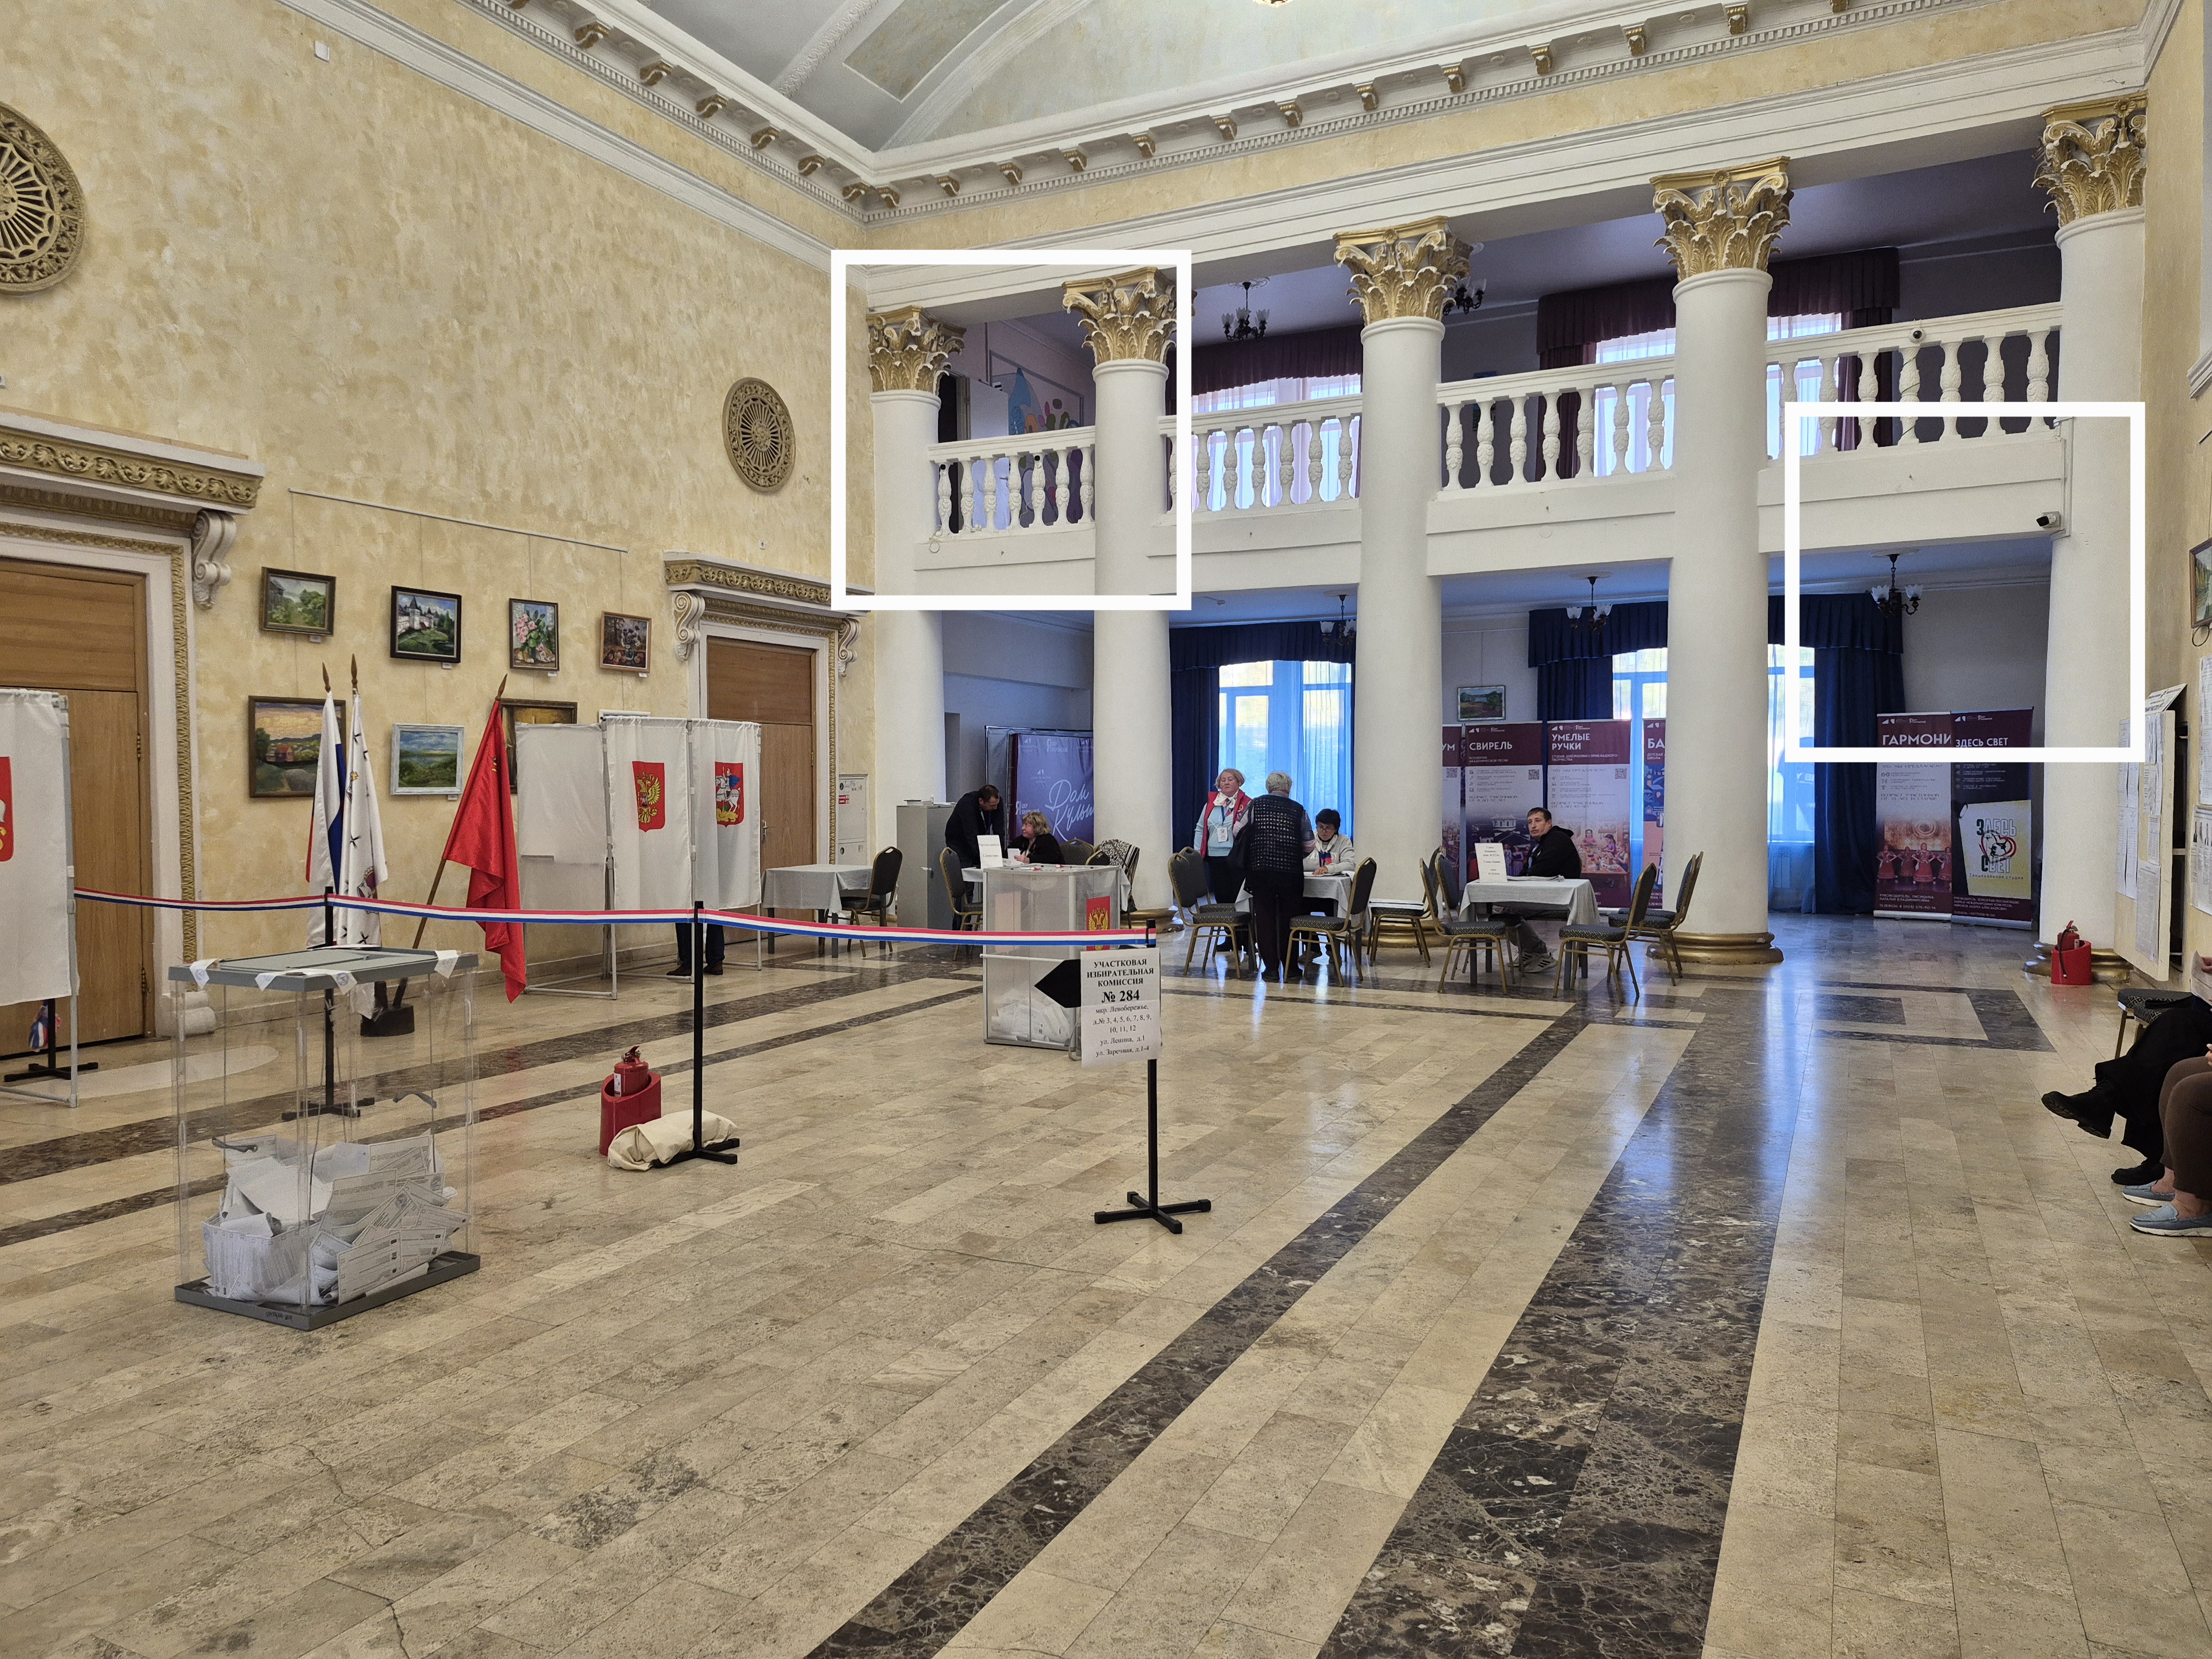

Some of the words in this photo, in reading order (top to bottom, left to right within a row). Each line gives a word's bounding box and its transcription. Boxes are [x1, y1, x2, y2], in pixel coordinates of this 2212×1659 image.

[1551, 733, 1590, 742] УМЕЛЫЕ
[1882, 733, 1951, 745] ГАРМОНИ
[1955, 738, 1984, 748] ЗДЕСЬ
[1986, 737, 2008, 747] СВЕТ
[1469, 741, 1512, 750] СВИРЕЛЬ
[1552, 742, 1582, 750] РУЧКИ
[1647, 738, 1665, 749] БА
[1045, 779, 1089, 812] Дом
[1976, 818, 2017, 838] ЗДЕСЬ
[1981, 855, 2012, 873] СВЕТ
[1093, 959, 1147, 968] УЧАСТКОВАЯ
[1087, 968, 1154, 978] ИЗБИРАТЕЛЬНАЯ
[1098, 978, 1144, 987] КОМИССИЯ
[1102, 991, 1115, 1003] №
[1119, 989, 1140, 1001] 284
